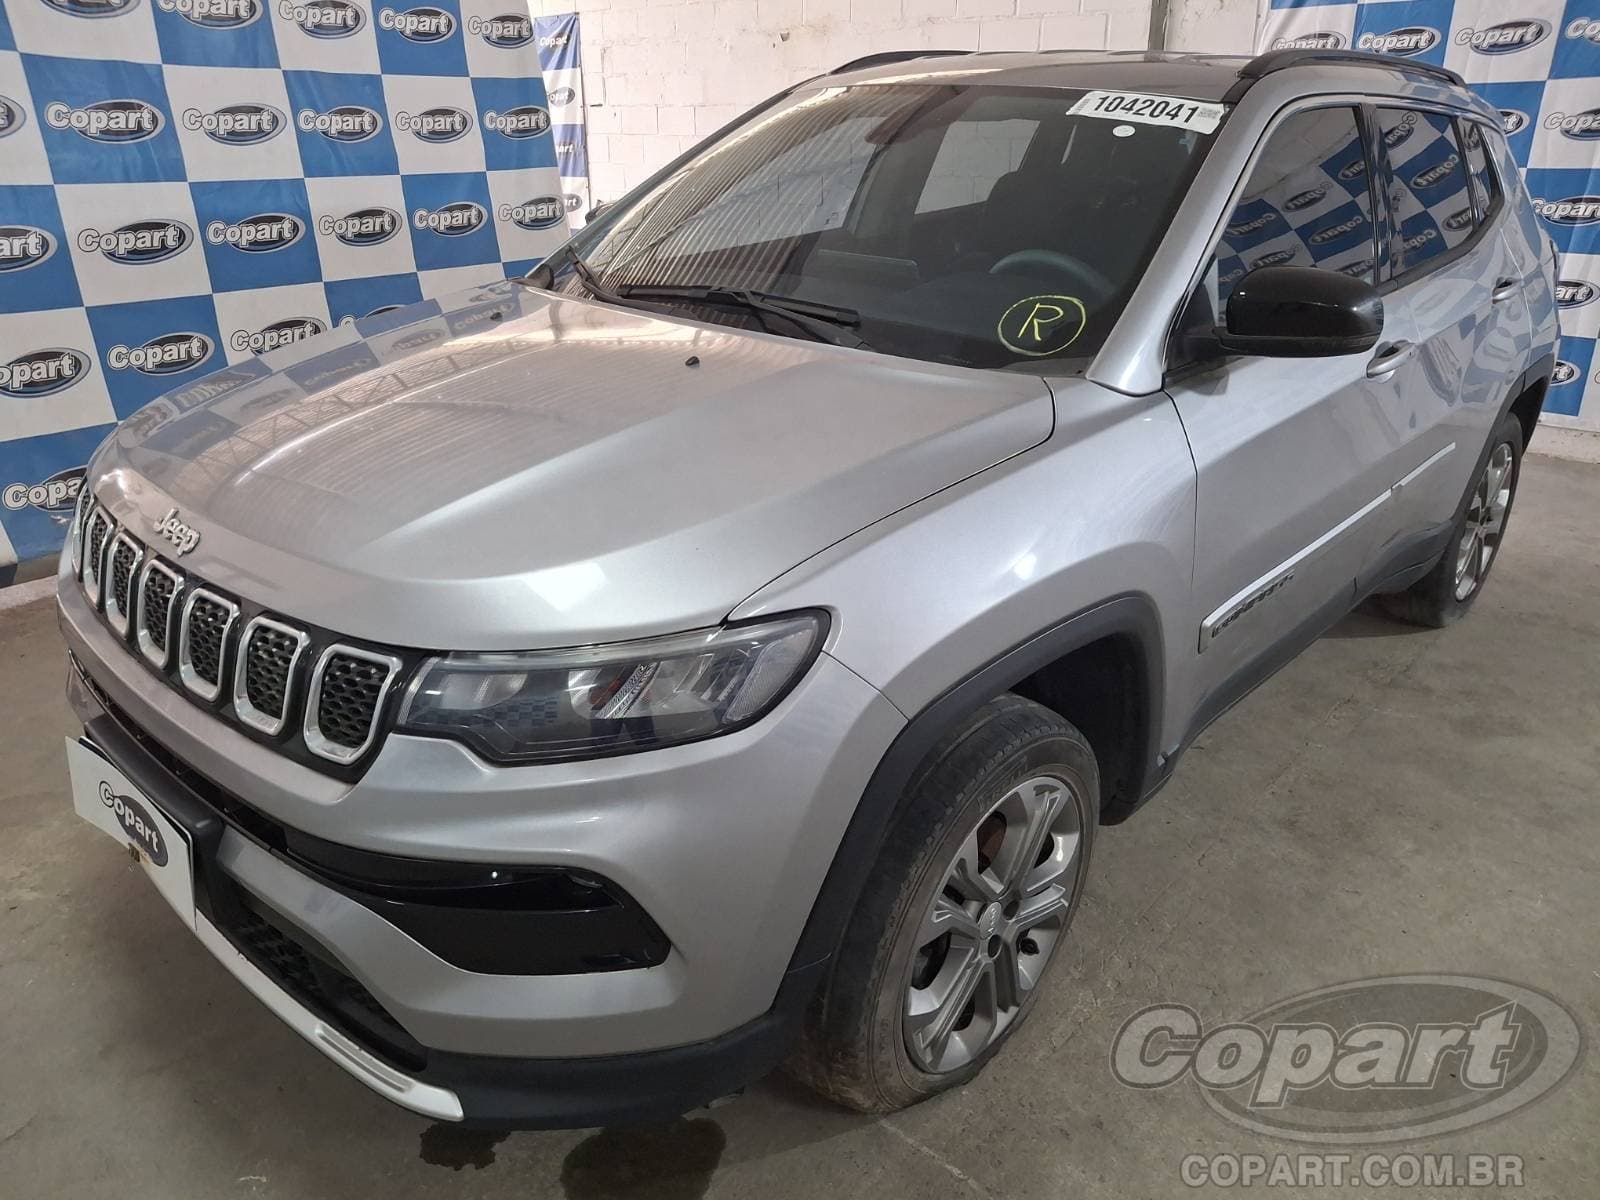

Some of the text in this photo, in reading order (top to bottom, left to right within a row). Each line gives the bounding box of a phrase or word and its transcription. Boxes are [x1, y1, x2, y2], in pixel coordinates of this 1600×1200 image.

[279, 0, 358, 28] Copart
[379, 8, 450, 34] Copart
[468, 16, 532, 38] Copart
[539, 33, 568, 48] Copart
[1358, 31, 1430, 53] Copart
[1455, 23, 1540, 50] Copart
[46, 102, 155, 136] Copart
[182, 108, 273, 136] Copart
[299, 108, 374, 136] Copart
[395, 111, 465, 134] Copart
[484, 110, 550, 132] Copart
[1094, 95, 1200, 124] 1042041
[1543, 111, 1600, 134] Copa
[319, 209, 394, 240] Copart
[413, 201, 482, 228] Copart
[498, 198, 565, 224] Copart
[0, 230, 42, 257] art
[78, 223, 180, 255] Copart
[207, 216, 294, 246] Copart
[231, 319, 316, 351] Copart
[1017, 302, 1064, 341] R
[107, 334, 203, 371] Copart
[0, 352, 75, 390] opart
[2, 477, 82, 510] Copa
[153, 508, 200, 557] Jeep
[98, 780, 159, 853] Copart
